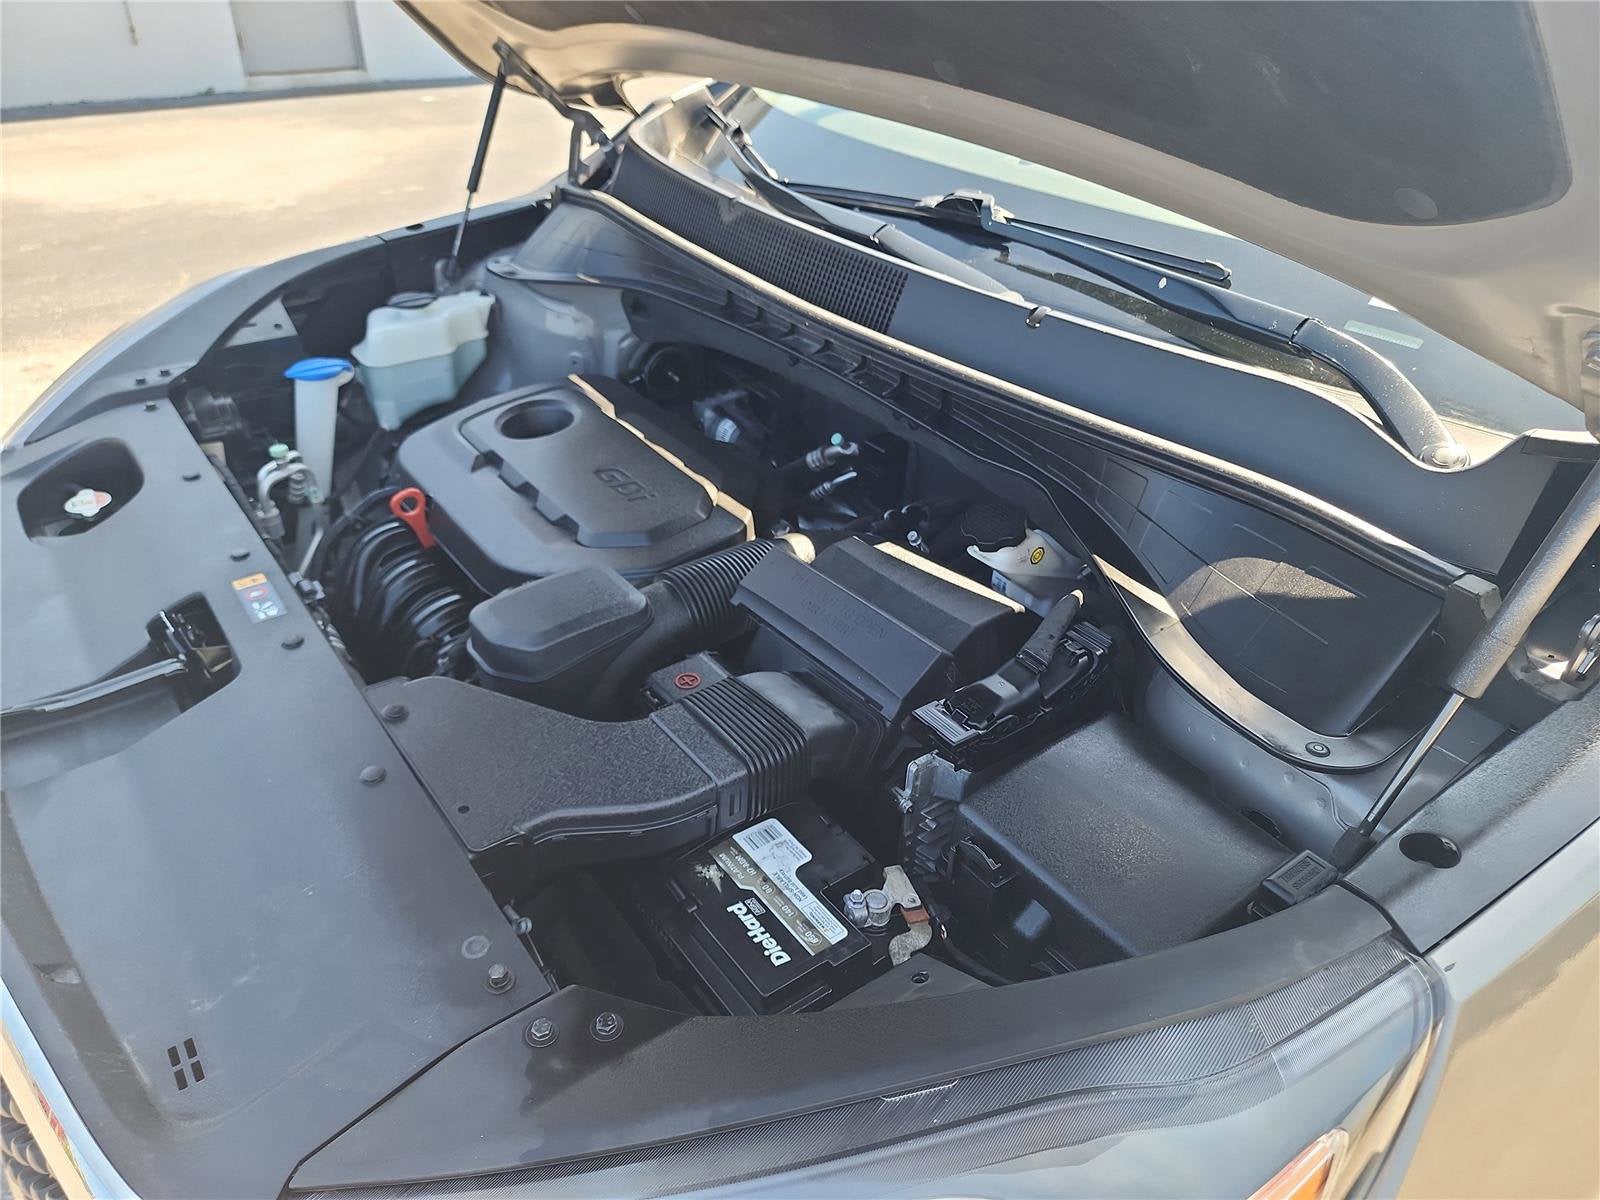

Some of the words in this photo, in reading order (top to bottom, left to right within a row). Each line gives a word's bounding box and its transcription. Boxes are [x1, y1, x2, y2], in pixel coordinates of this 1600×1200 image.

[781, 904, 794, 917] 140
[726, 901, 791, 967] DieHard
[804, 930, 819, 944] 850
